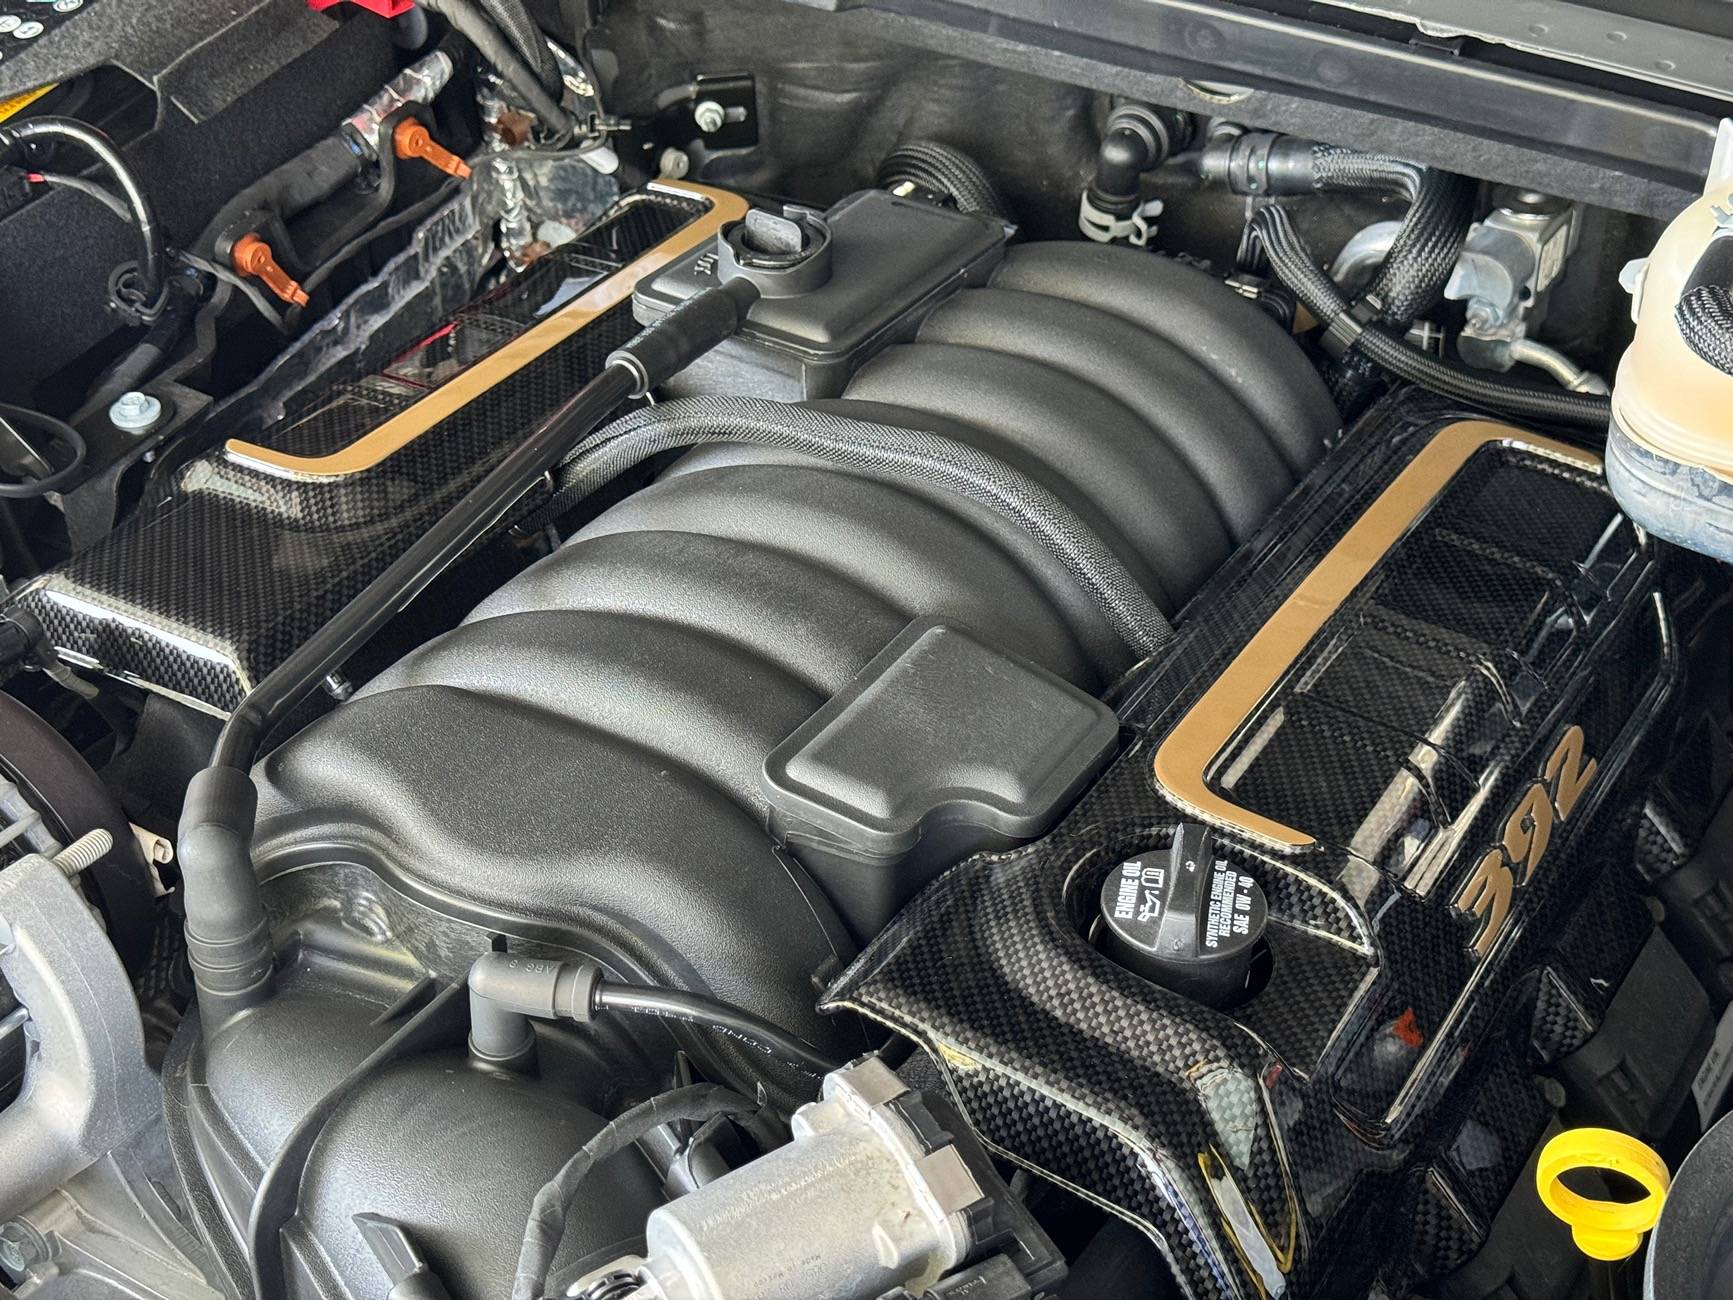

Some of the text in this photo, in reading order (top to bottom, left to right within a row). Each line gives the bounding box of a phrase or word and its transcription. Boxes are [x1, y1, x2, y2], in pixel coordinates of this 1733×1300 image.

[1457, 725, 1598, 957] 392
[1114, 861, 1142, 919] ENGINE OIL
[1205, 860, 1228, 948] SYNTHETIC ENGINE OIL
[1219, 870, 1237, 938] RECOMMENDED
[1233, 913, 1250, 935] SAE
